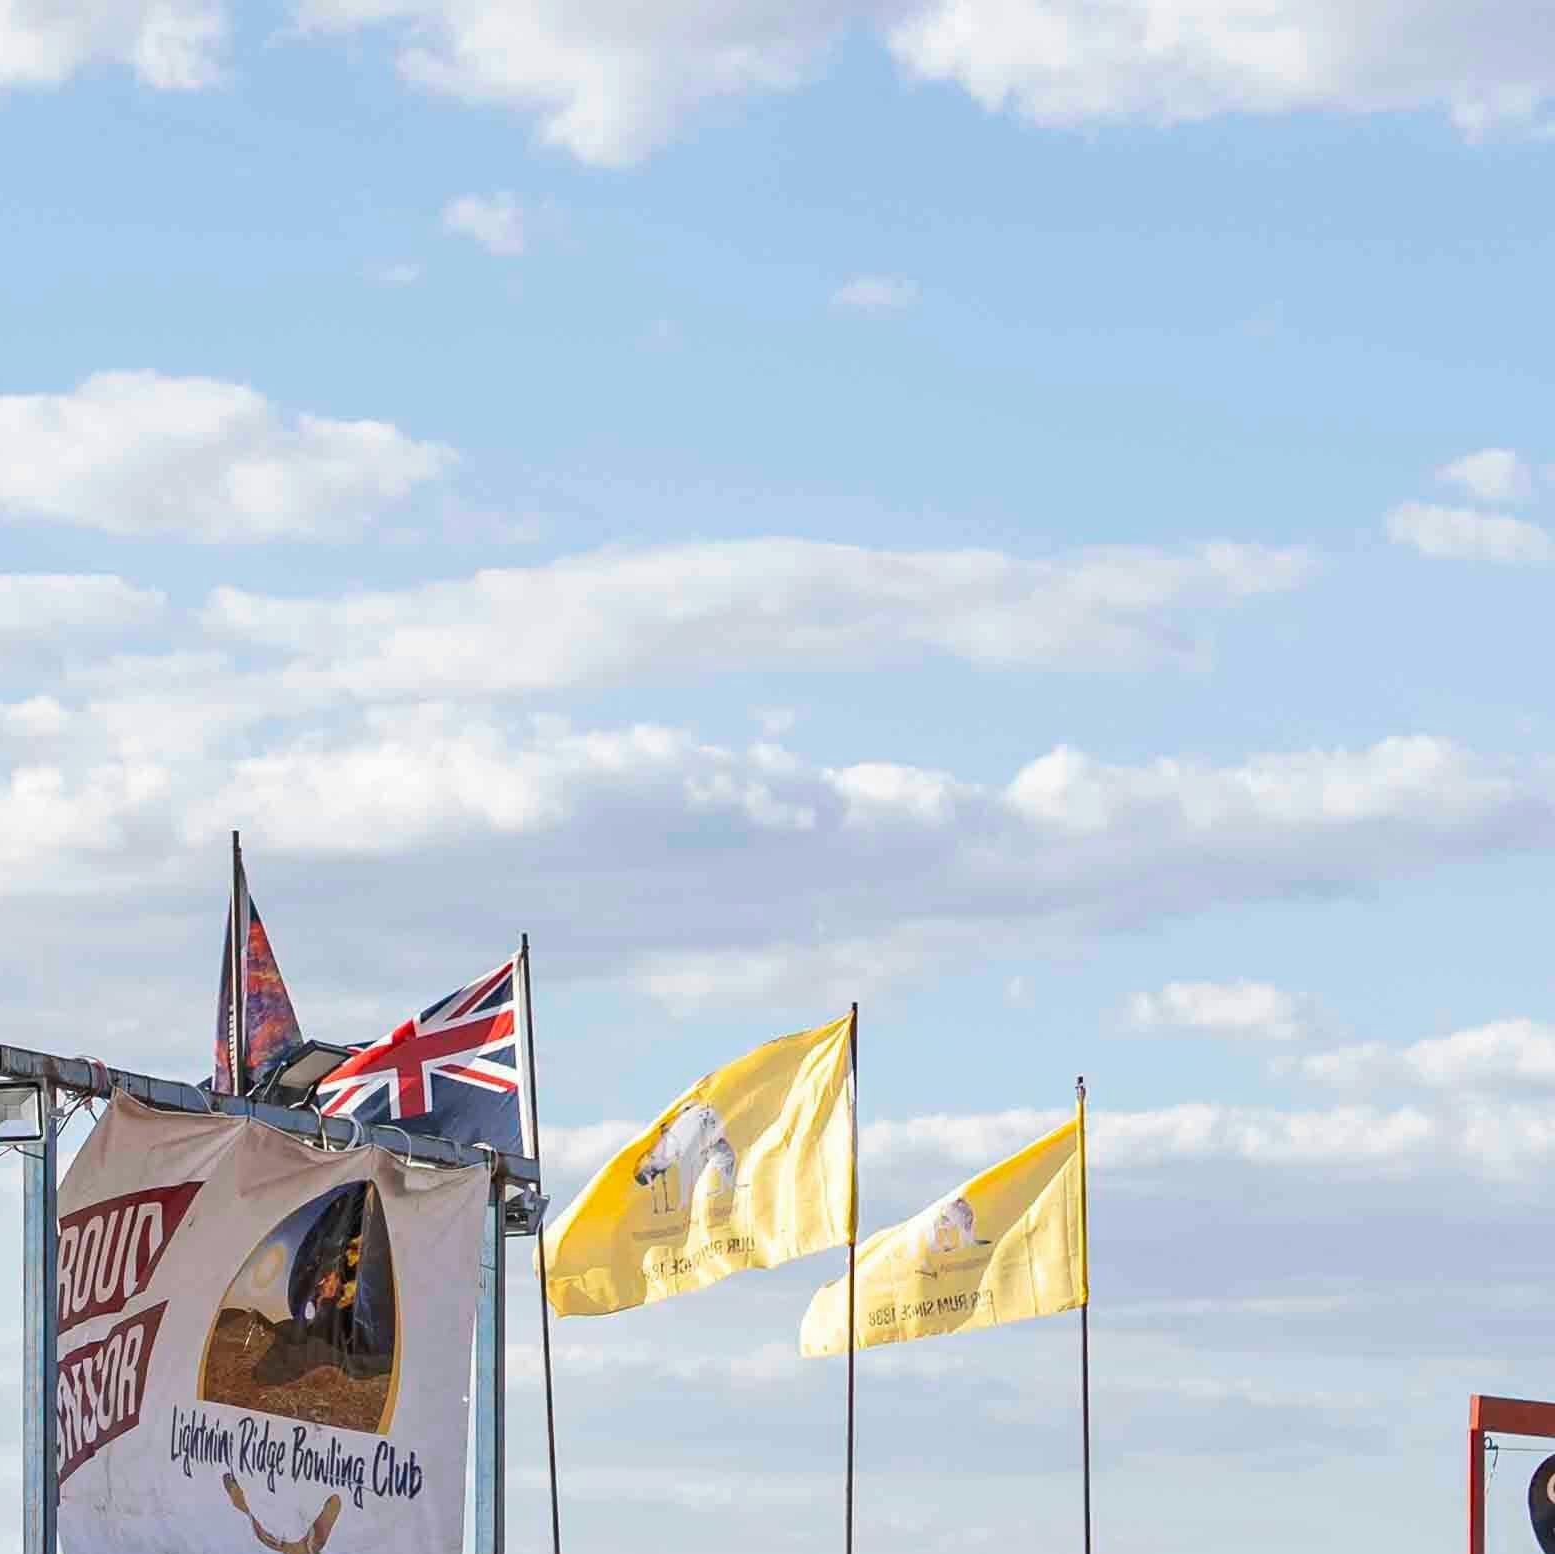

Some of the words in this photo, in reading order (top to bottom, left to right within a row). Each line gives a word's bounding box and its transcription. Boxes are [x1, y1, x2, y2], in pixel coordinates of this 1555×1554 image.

[57, 1323, 144, 1472] NSOR
[239, 1416, 285, 1494] Ridge
[291, 1425, 365, 1509] Bowling
[372, 1440, 423, 1499] Club
